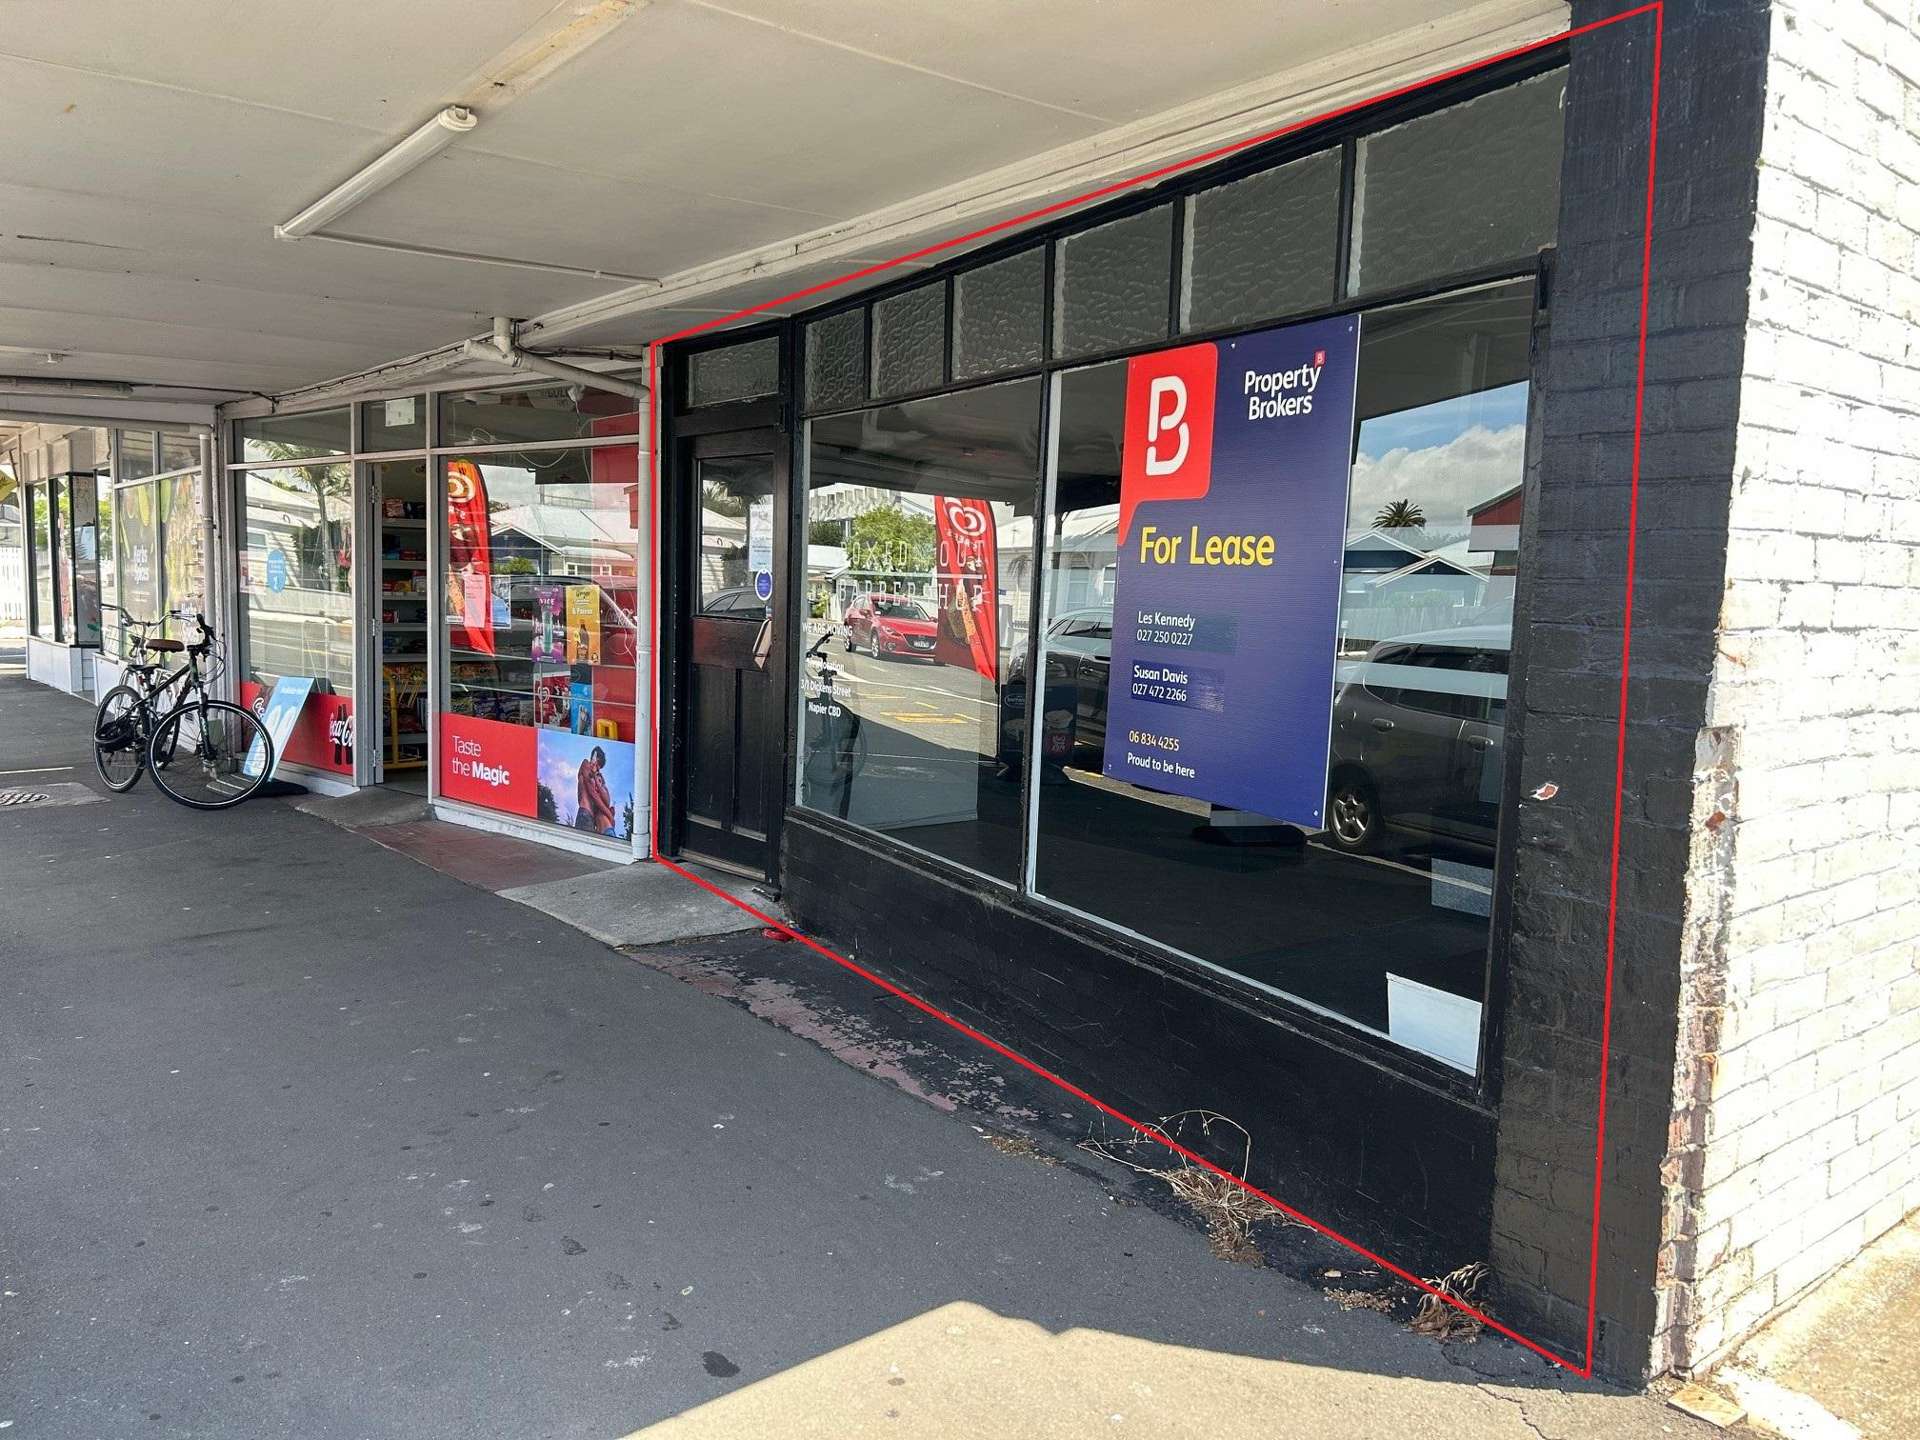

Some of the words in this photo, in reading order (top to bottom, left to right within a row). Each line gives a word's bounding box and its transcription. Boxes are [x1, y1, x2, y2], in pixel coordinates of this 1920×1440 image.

[1244, 363, 1322, 398] Property
[1248, 392, 1313, 421] Brokers
[939, 540, 985, 568] OUT
[1140, 526, 1182, 565] For
[1190, 525, 1275, 566] Lease
[801, 622, 812, 633] WE
[1138, 611, 1153, 624] Les
[1155, 612, 1196, 631] Kennedy
[1136, 629, 1152, 642] 027
[1153, 631, 1170, 643] 250
[1171, 632, 1193, 646] 0227
[1134, 665, 1160, 680] Susan
[1162, 668, 1189, 684] Davis
[833, 685, 851, 698] Street
[1132, 683, 1148, 695] 027
[1149, 685, 1165, 698] 472
[1166, 688, 1187, 702] 2266
[808, 701, 827, 714] Napier
[828, 705, 841, 718] CBD
[452, 735, 482, 757] Taste
[1129, 730, 1140, 743] 06
[1140, 733, 1157, 747] 834
[1158, 736, 1180, 751] 4255
[452, 757, 471, 776] the
[472, 761, 510, 786] Magic
[1127, 752, 1151, 768] Proud
[1152, 758, 1161, 770] to
[1163, 760, 1174, 773] be
[1175, 763, 1195, 778] here
